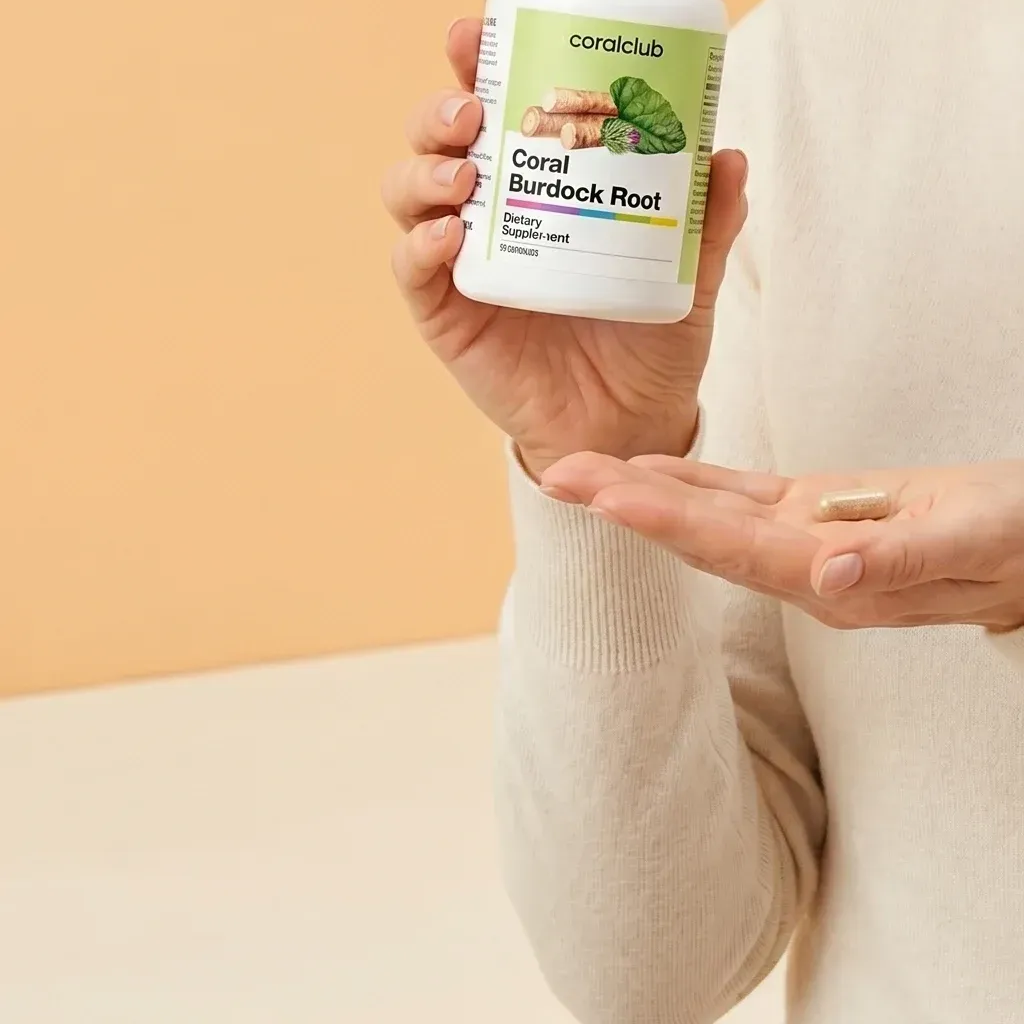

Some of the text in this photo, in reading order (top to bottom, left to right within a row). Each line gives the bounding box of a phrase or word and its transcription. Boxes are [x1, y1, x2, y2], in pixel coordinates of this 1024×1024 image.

[569, 34, 664, 58] coralclub
[512, 148, 570, 174] Coral
[509, 173, 662, 211] Burdock Root
[503, 212, 543, 230] Dietary
